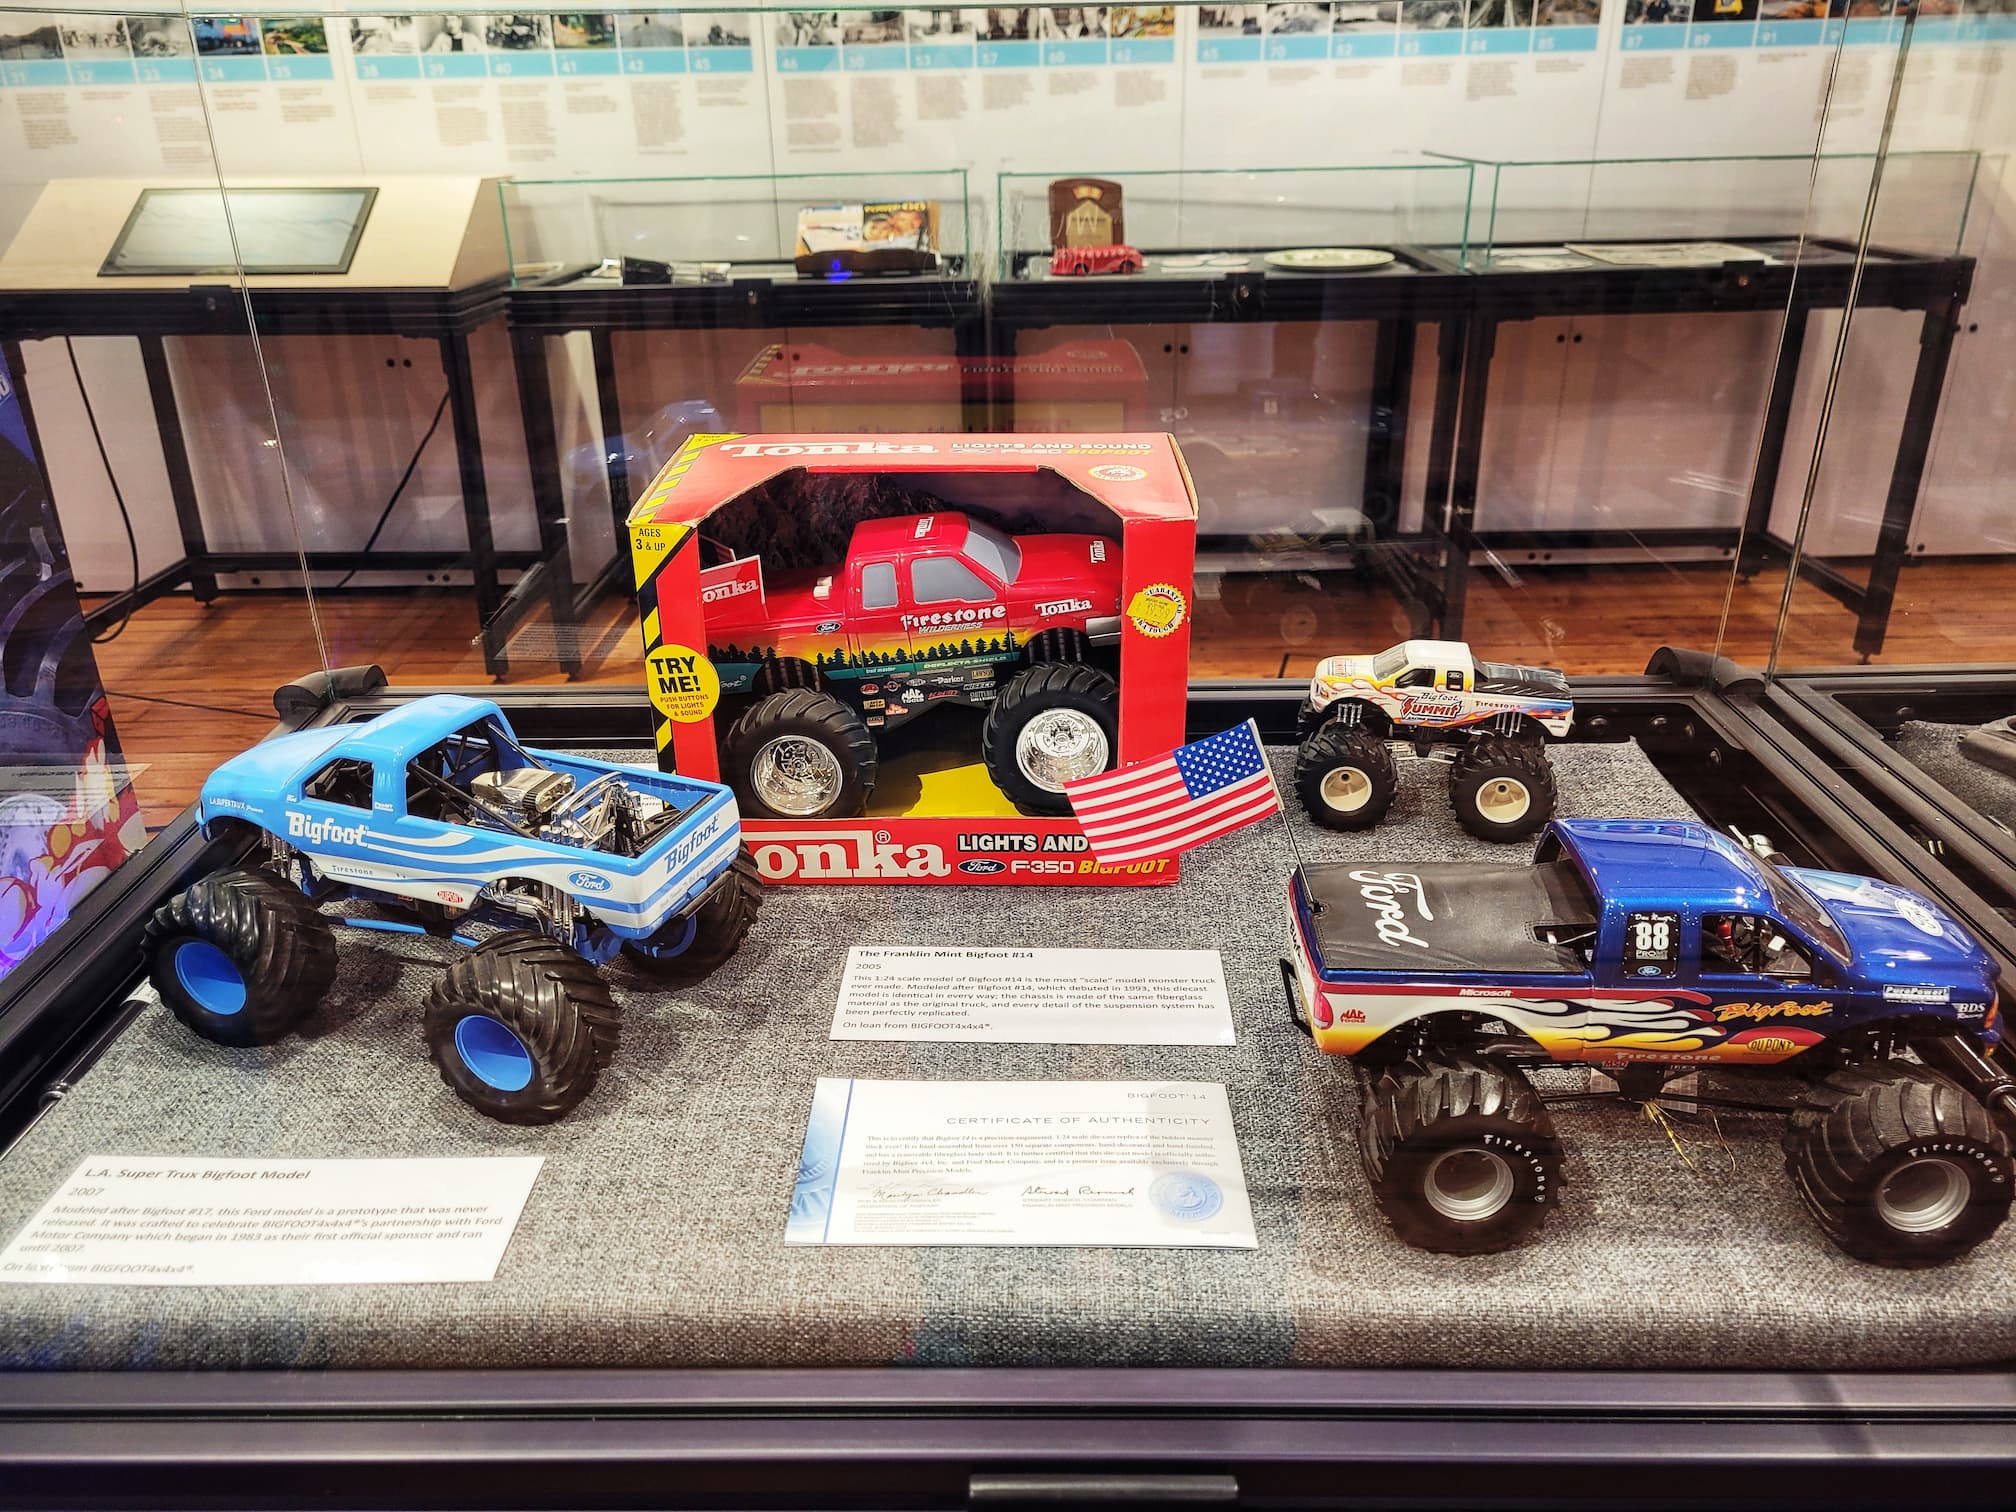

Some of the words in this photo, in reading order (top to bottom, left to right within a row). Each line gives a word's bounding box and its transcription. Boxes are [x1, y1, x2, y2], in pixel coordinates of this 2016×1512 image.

[720, 442, 939, 457] Tonka
[1080, 443, 1152, 451] SOUND
[638, 527, 661, 538] AGES
[636, 539, 643, 550] 3
[645, 541, 652, 551] &
[654, 541, 666, 551] UP
[1035, 598, 1092, 617] Tonka
[901, 605, 1006, 631] Firestone
[816, 622, 840, 633] Ford
[918, 622, 983, 634] WILDERNESS
[650, 656, 695, 675] TRY
[658, 676, 701, 694] ME!
[679, 694, 709, 702] BUTTONS
[1420, 692, 1459, 702] Bigfoot
[1402, 697, 1461, 718] SUMMIT
[1475, 700, 1521, 709] Firestone
[285, 811, 368, 847] Bigfoot
[664, 813, 720, 874] Bigfoot
[958, 834, 1037, 853] LIGHTS
[1043, 834, 1088, 853] AND
[333, 865, 374, 875] Firestone
[962, 860, 1002, 874] Ford
[1011, 860, 1075, 875] F-350
[574, 872, 606, 891] Ford
[1348, 870, 1434, 948] Ford
[1636, 922, 1669, 950] 88
[965, 951, 1008, 959] Bigfoot
[1156, 993, 1203, 1001] fiberglass
[1459, 988, 1513, 998] Microsoft
[921, 1000, 958, 1008] original
[1959, 1003, 1986, 1013] BDS
[871, 1008, 916, 1016] perfectly
[1340, 1009, 1366, 1020] MAC
[1712, 1000, 1834, 1023] Bigfoot
[1616, 1052, 1721, 1061] Firestone
[1059, 1116, 1080, 1124] OF
[1088, 1116, 1210, 1125] AUTHENTICITY
[1483, 1134, 1545, 1191] Firestone
[1908, 1143, 1997, 1173] Firestone
[116, 1168, 163, 1179] Super
[166, 1169, 199, 1178] Trux
[201, 1169, 257, 1180] Bigfoot
[259, 1170, 311, 1179] Model
[67, 1187, 105, 1196] 2007
